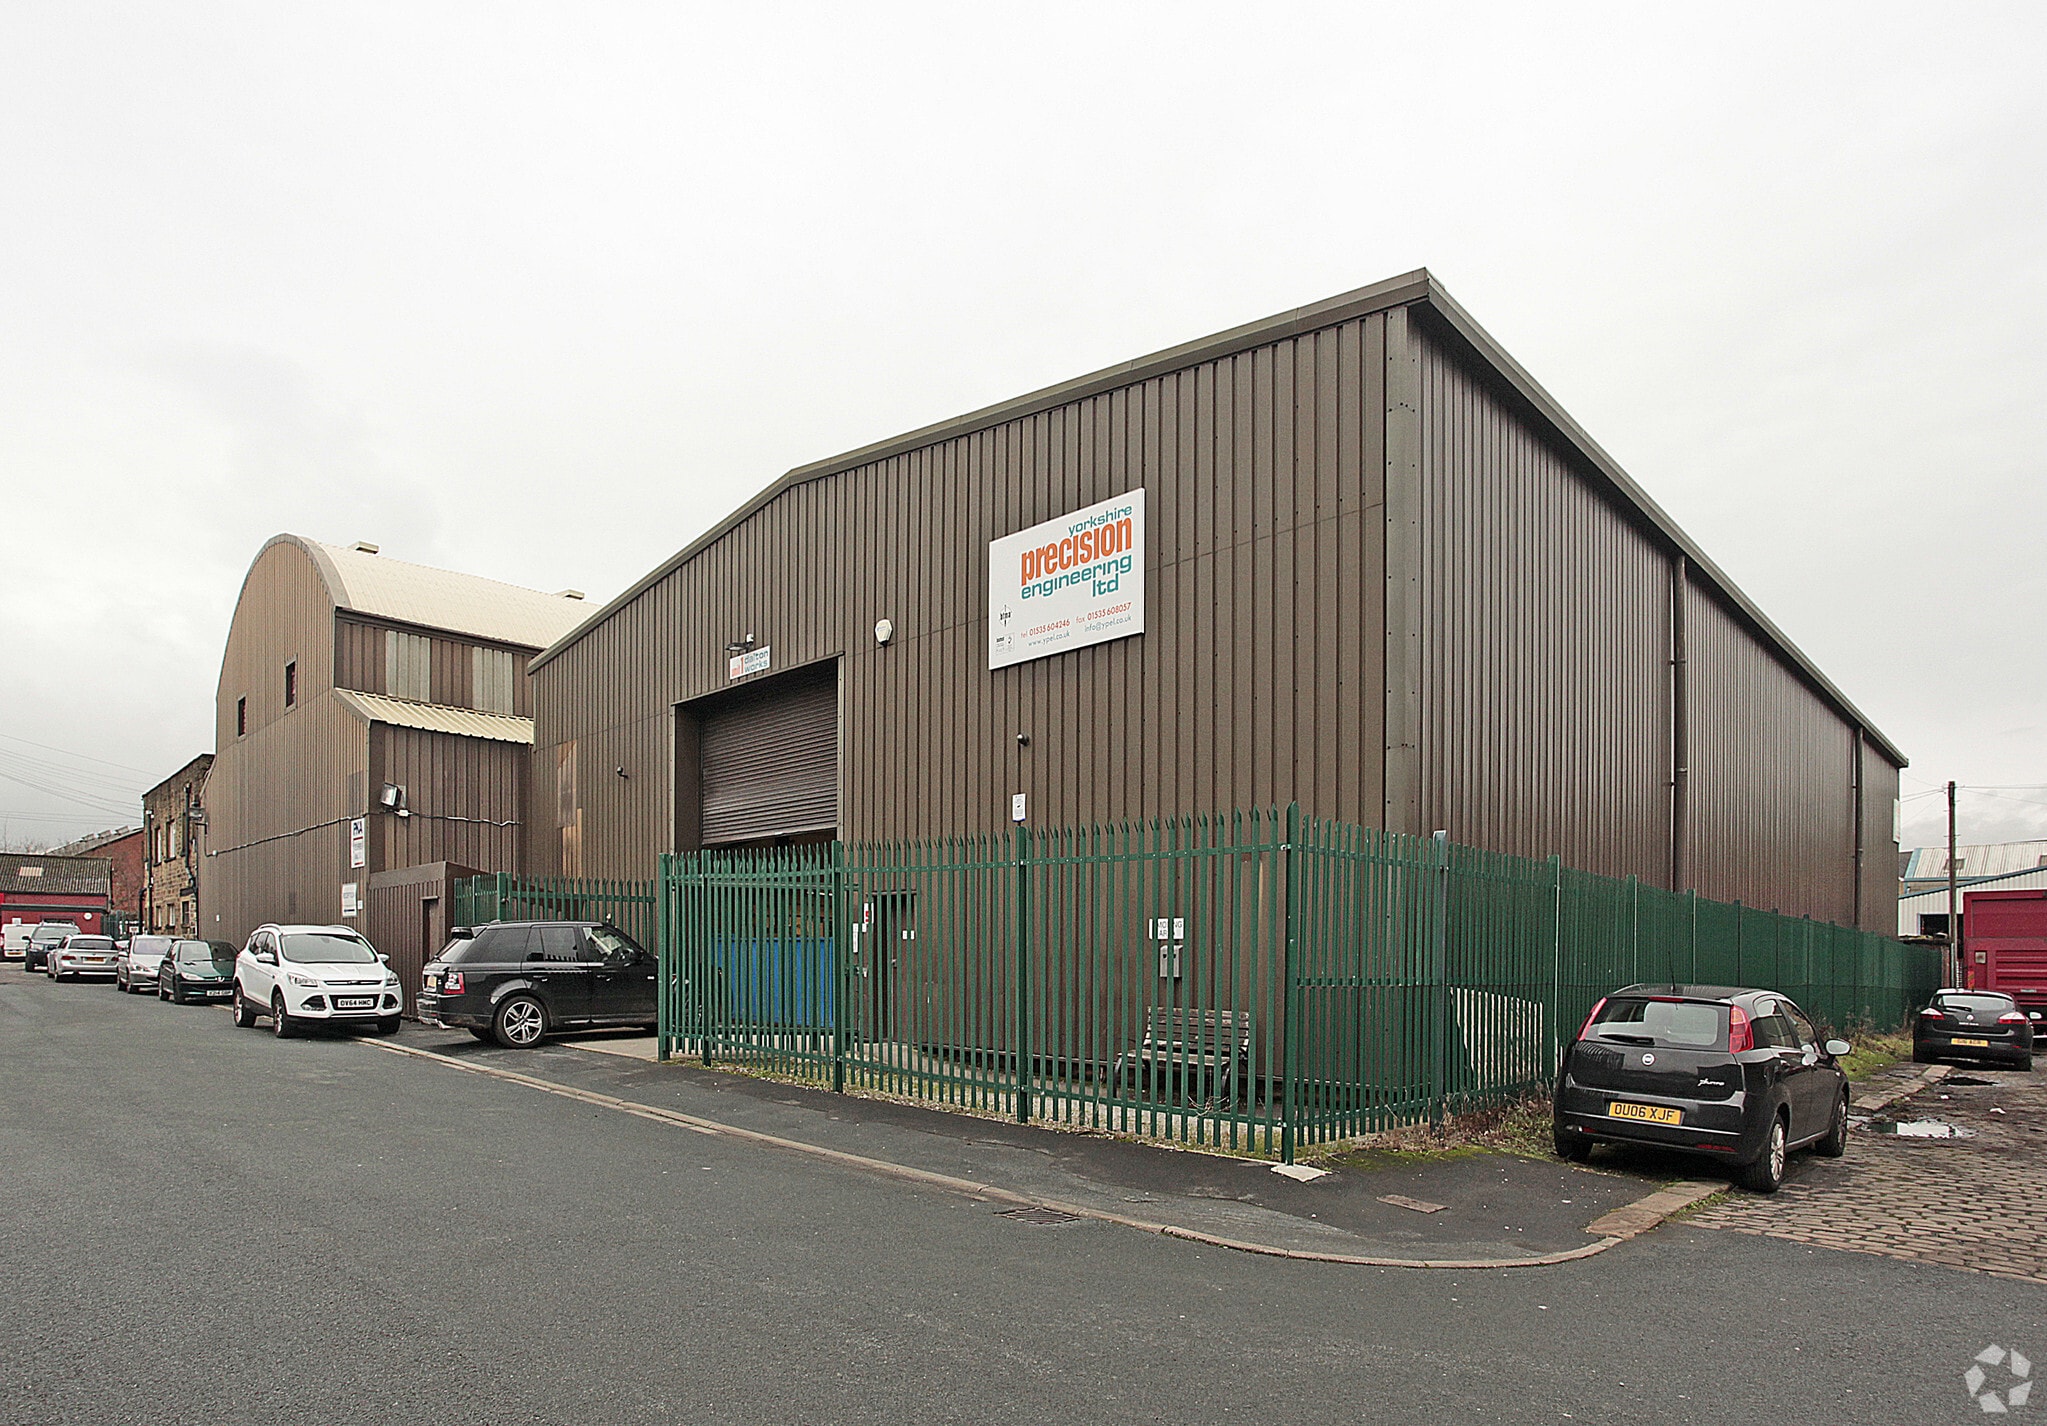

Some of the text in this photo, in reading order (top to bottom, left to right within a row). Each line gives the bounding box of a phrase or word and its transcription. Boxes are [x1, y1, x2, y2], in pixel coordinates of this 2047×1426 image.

[1068, 505, 1133, 537] yorkshire
[1021, 517, 1132, 586] precision
[1021, 554, 1132, 600] engineering
[1092, 573, 1119, 597] ltd
[1084, 614, 1132, 632] info@ypel.co.uk
[1087, 608, 1106, 621] 01535
[1020, 618, 1071, 638] tel 01535 604246
[1028, 630, 1070, 647] www.ypel.co.uk
[744, 650, 769, 664] dalton
[744, 660, 768, 673] works
[1614, 1103, 1675, 1121] OU06 XJF
